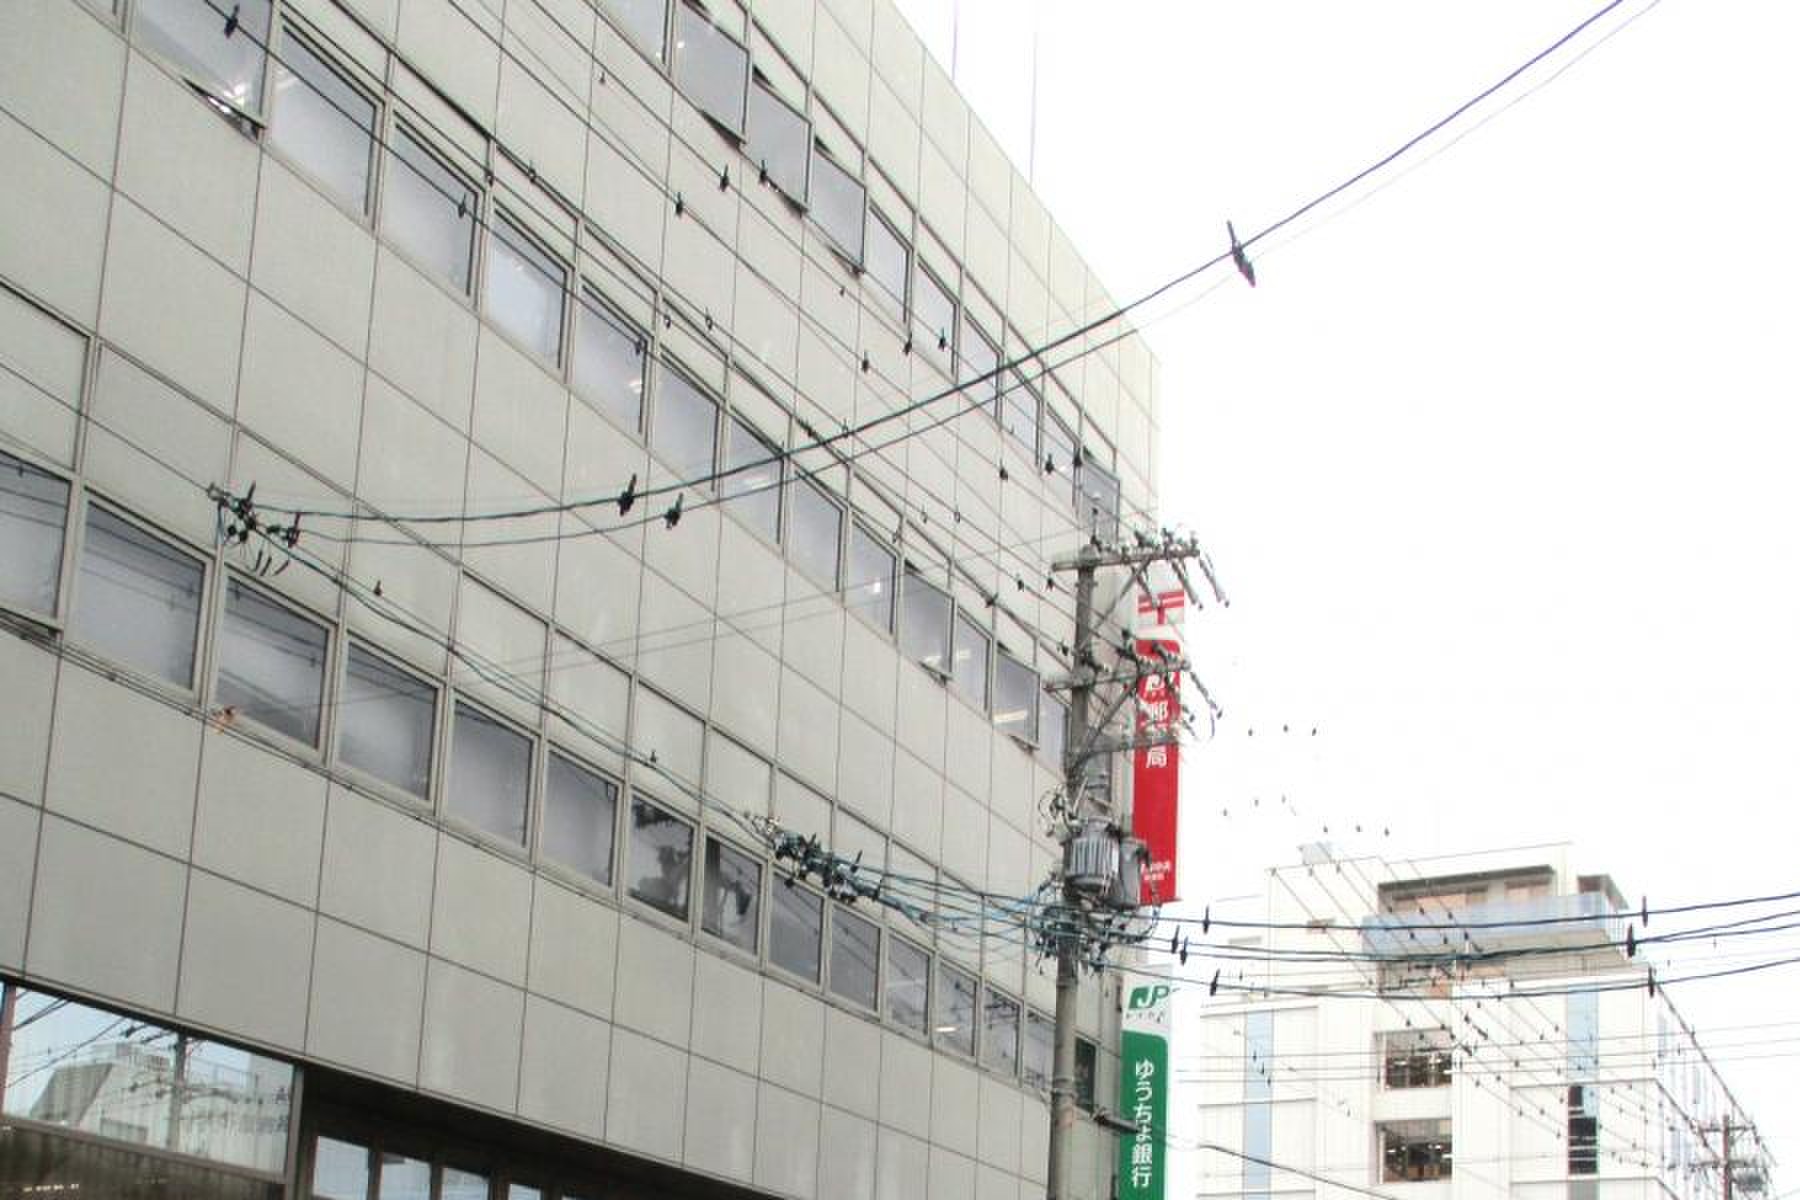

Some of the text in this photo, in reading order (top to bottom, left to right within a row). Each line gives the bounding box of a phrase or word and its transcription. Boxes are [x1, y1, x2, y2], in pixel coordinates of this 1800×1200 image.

[1127, 985, 1170, 1010] JP
[1131, 1058, 1154, 1188] ゆうちょ銀行
